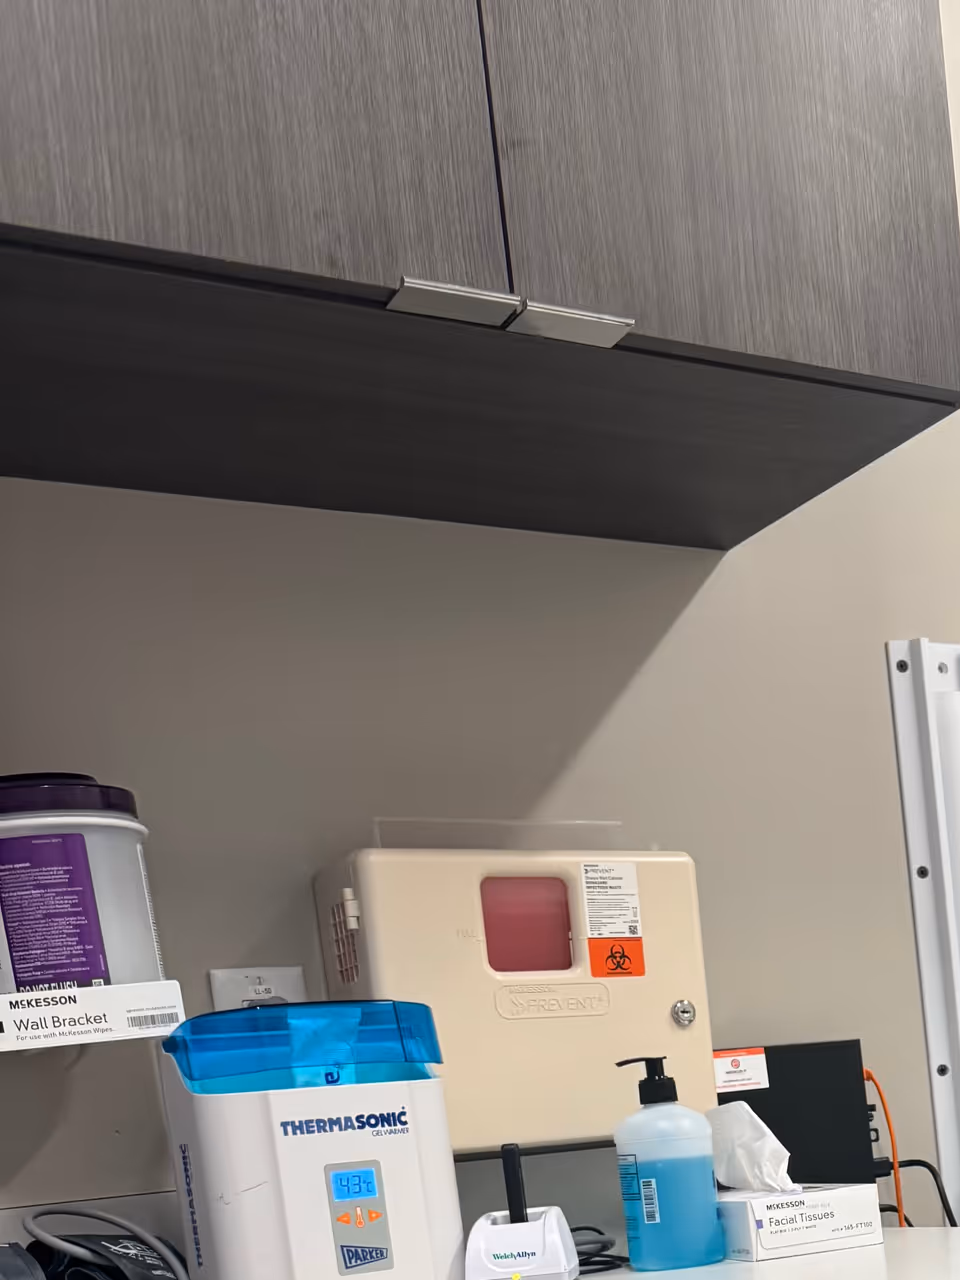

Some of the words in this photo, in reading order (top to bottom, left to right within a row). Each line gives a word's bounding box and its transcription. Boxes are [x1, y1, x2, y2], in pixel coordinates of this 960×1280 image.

[13, 1017, 48, 1032] Wall
[52, 1013, 108, 1028] Bracket
[59, 1028, 92, 1037] McKesson
[280, 1110, 408, 1136] THERMASONIC
[384, 1127, 409, 1136] WARMER
[769, 1214, 797, 1227] Facial
[799, 1210, 835, 1223] Tissues
[346, 1249, 385, 1264] PARKER
